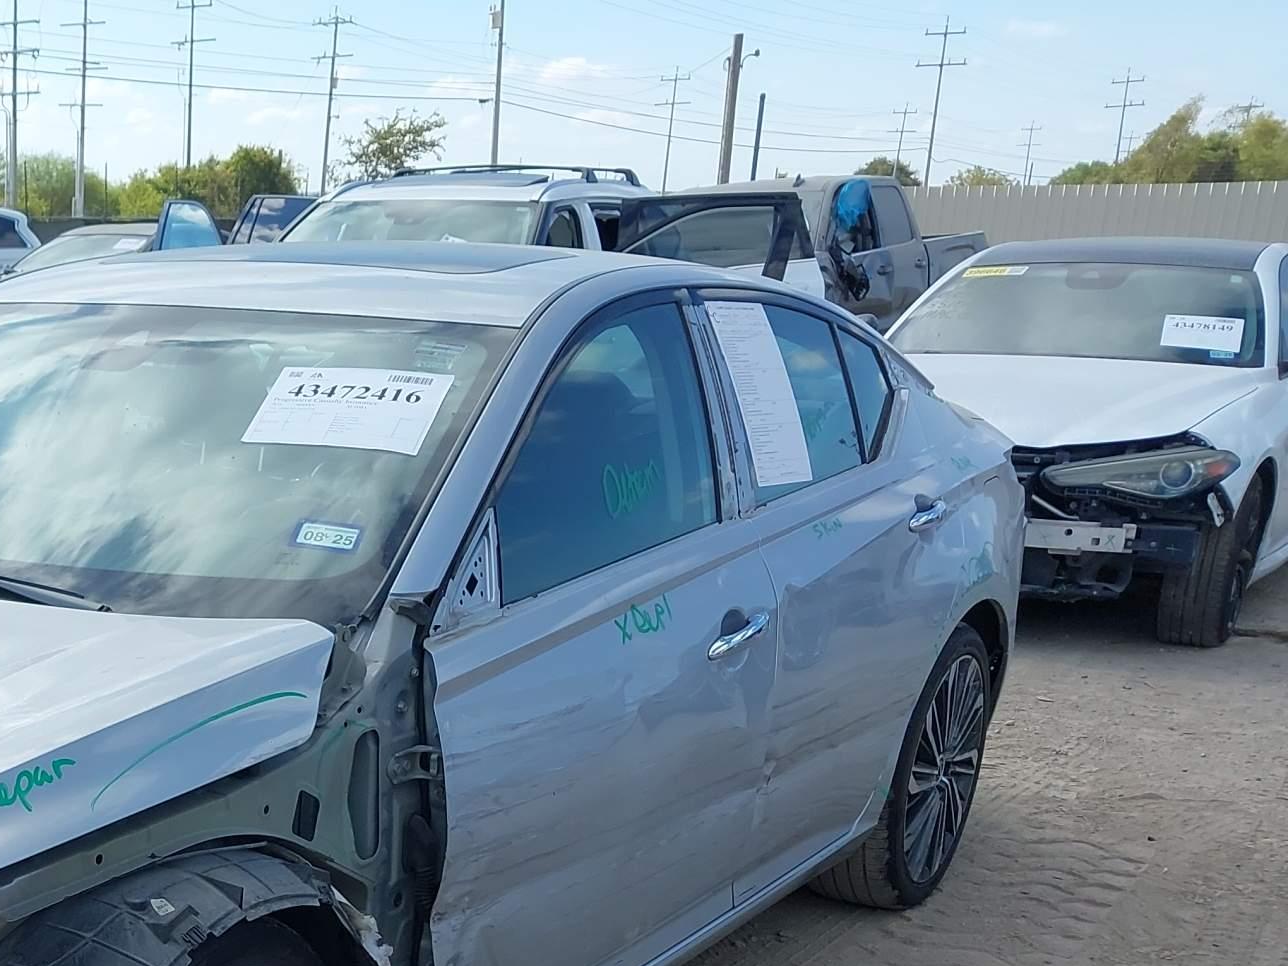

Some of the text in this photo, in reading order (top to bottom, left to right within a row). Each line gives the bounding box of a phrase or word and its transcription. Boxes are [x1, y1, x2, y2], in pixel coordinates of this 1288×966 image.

[287, 383, 425, 404] 43472416
[303, 530, 325, 542] 08
[331, 533, 354, 546] 25
